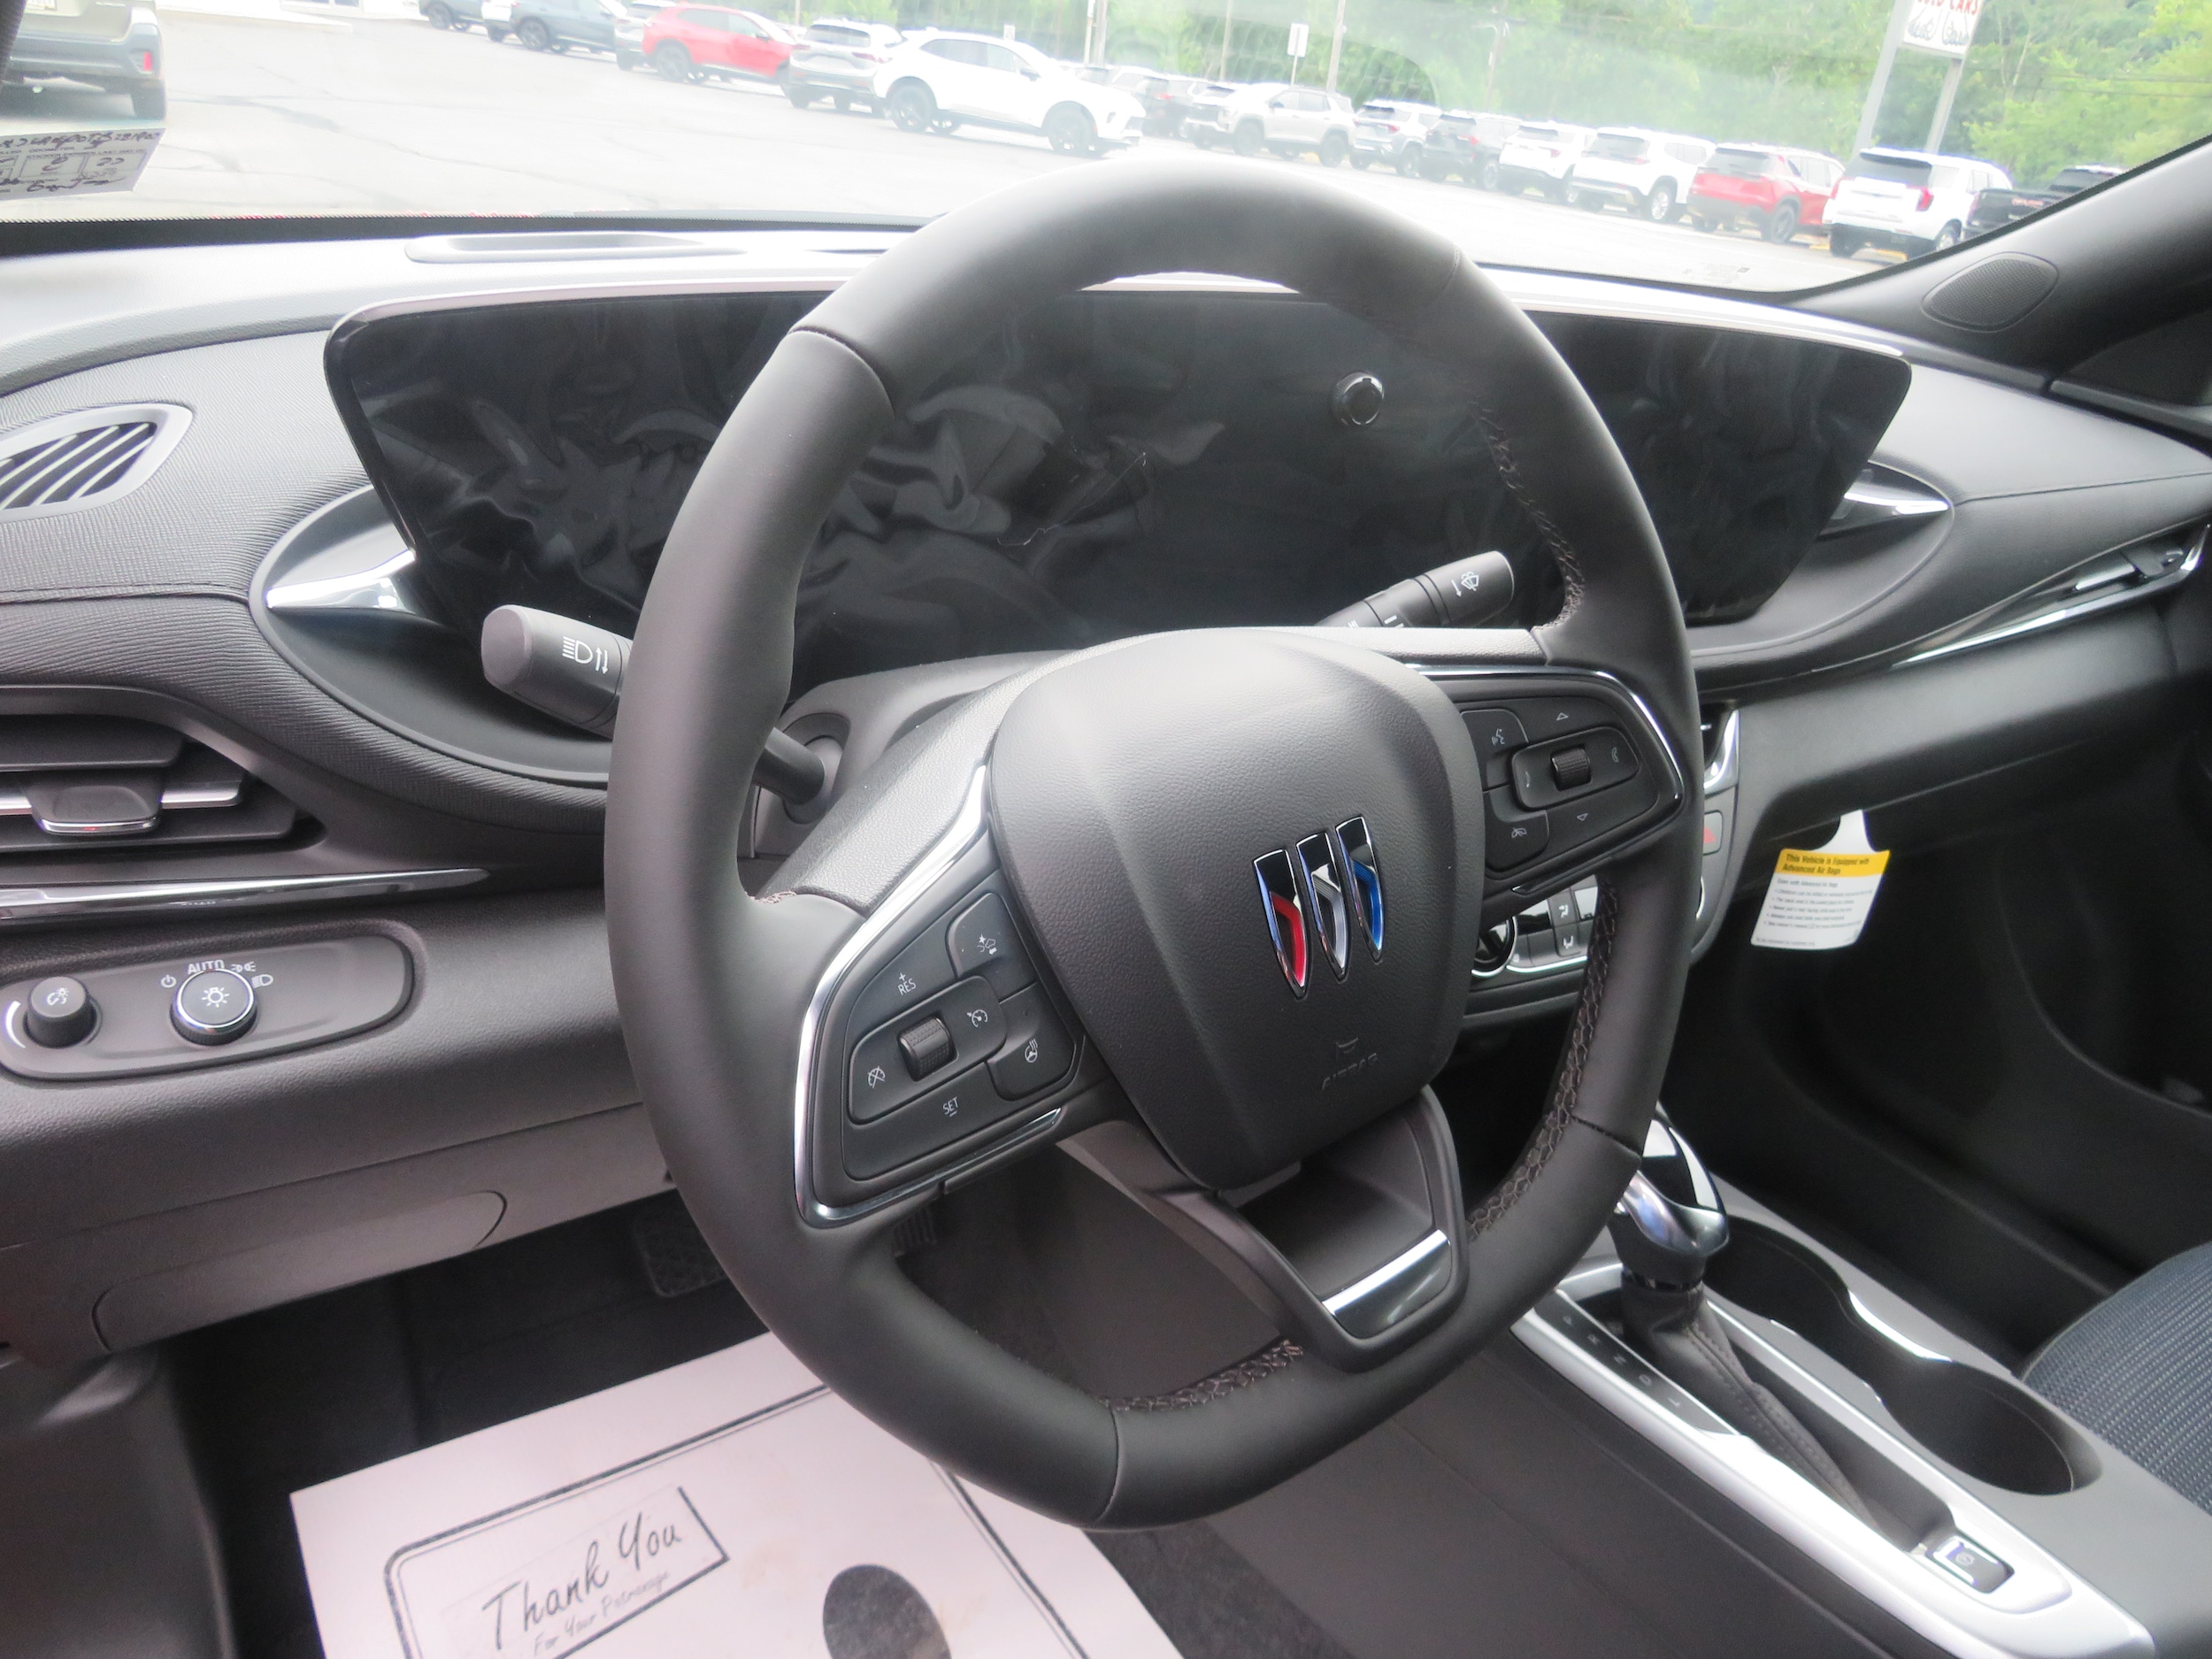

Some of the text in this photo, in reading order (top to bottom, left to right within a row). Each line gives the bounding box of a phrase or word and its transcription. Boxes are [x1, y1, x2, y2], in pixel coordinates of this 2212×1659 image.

[188, 959, 226, 975] AUTO
[898, 978, 917, 995] RES
[942, 1096, 958, 1115] SET
[481, 1511, 682, 1651] Thank You
